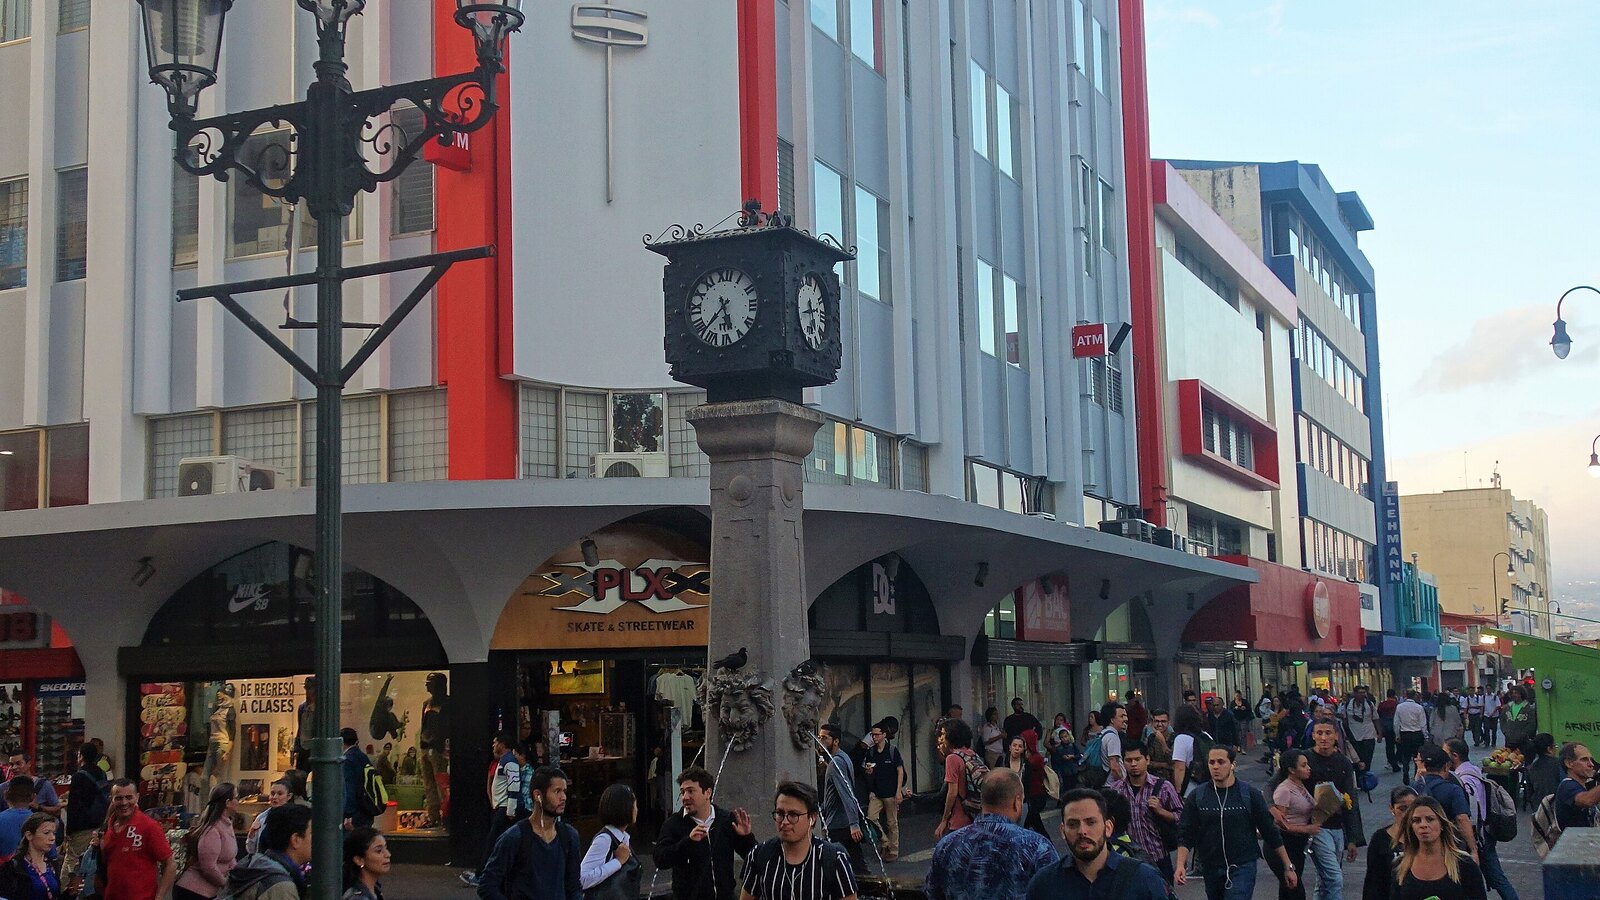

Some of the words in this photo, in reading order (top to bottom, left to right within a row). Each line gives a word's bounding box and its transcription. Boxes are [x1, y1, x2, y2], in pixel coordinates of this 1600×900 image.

[1076, 333, 1103, 347] ATM
[1386, 496, 1401, 581] LEHMANN
[254, 598, 269, 611] SB
[567, 621, 605, 632] SKATE
[608, 623, 615, 632] &
[618, 620, 695, 632] STREETWEAR
[240, 683, 252, 696] DE
[254, 682, 294, 696] REGRESO
[240, 700, 248, 713] A
[251, 699, 294, 713] CLASES
